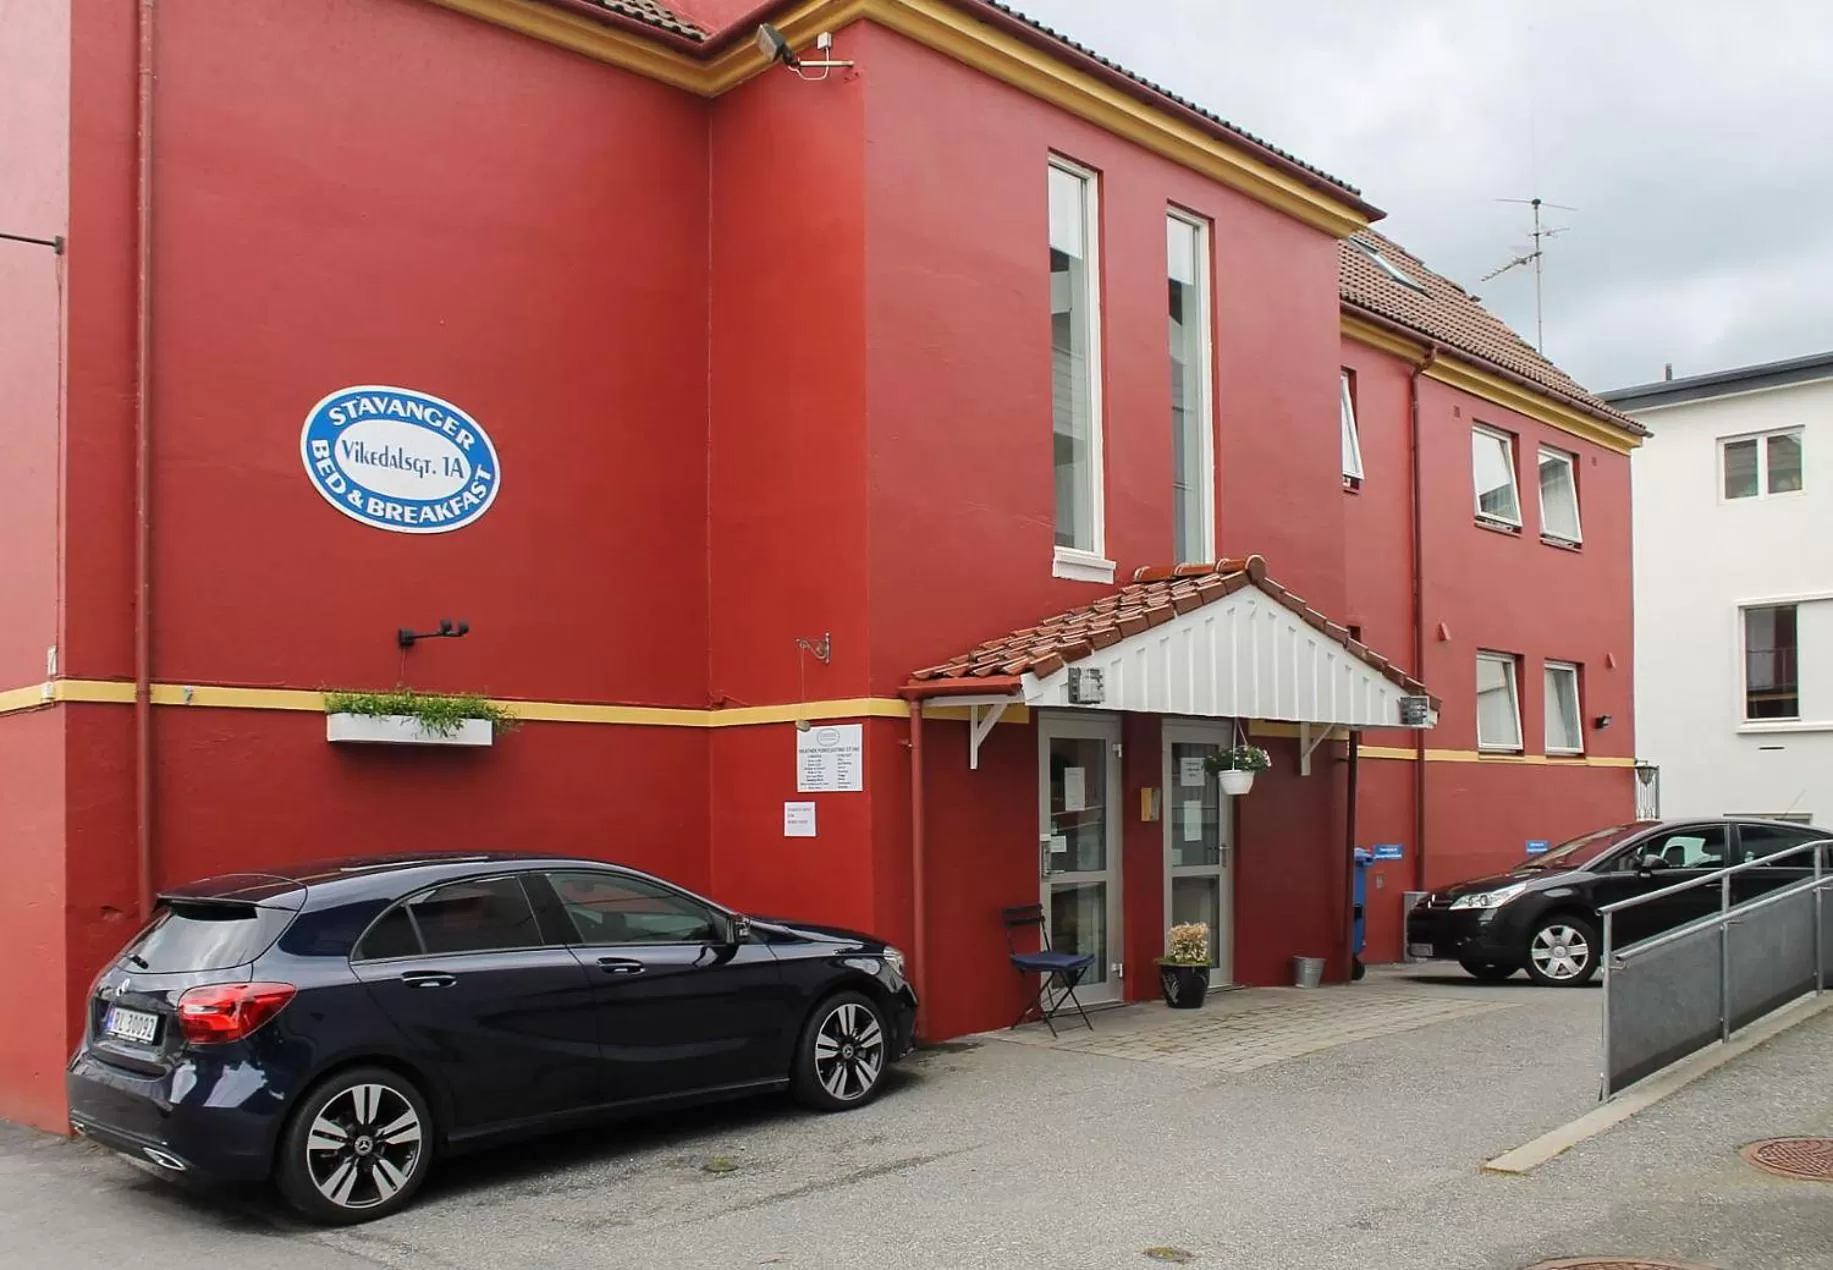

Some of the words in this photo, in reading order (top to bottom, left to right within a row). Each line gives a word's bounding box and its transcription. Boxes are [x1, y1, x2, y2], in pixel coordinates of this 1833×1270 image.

[329, 396, 475, 451] STAVANGER
[312, 439, 346, 494] BED
[347, 490, 364, 508] &
[366, 464, 492, 524] BREAKFAST
[442, 457, 464, 478] 1A
